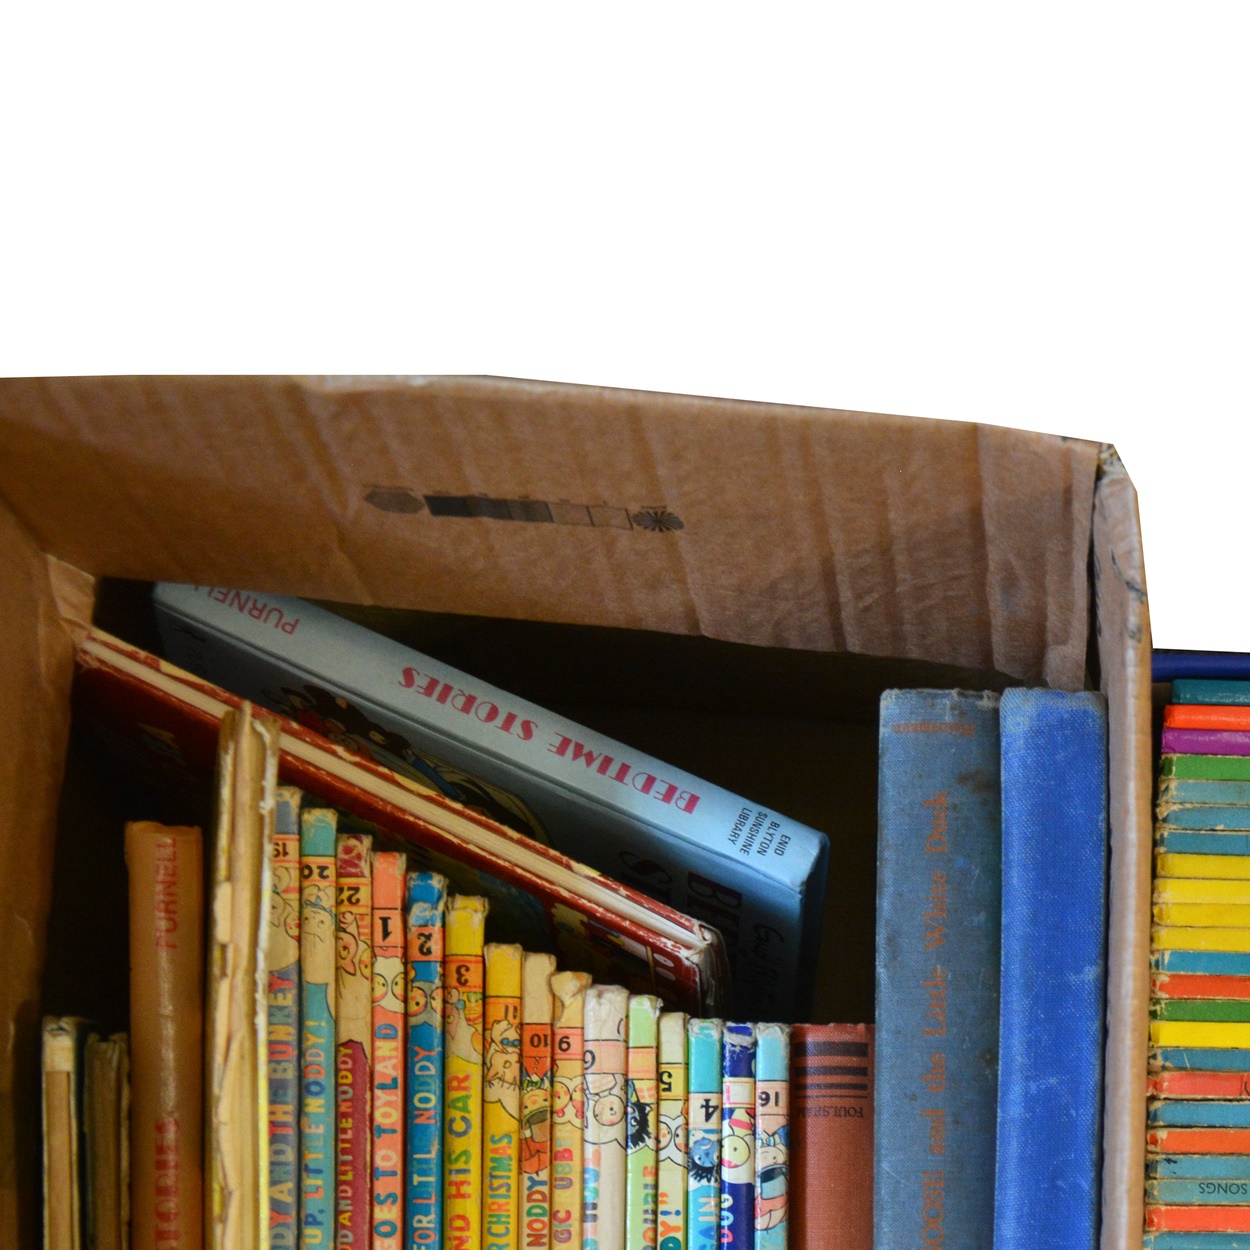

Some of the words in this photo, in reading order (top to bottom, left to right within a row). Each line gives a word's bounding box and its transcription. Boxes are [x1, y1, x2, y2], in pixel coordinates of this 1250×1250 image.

[397, 666, 539, 741] STORIES
[547, 732, 701, 815] BEDTIME
[728, 807, 752, 846] LIBRARY
[739, 811, 769, 857] SUNSHINE
[756, 821, 781, 857] BLYTON
[776, 833, 792, 857] ENID
[379, 916, 393, 941] 1
[455, 964, 470, 985] 3
[530, 1026, 548, 1047] 10
[375, 1023, 398, 1139] TOYLAND
[659, 1070, 672, 1093] 5
[447, 1073, 471, 1137] CAR
[375, 1149, 398, 1180] TO
[447, 1148, 471, 1199] HIS
[489, 1134, 513, 1238] CHRISTMAS
[526, 1174, 548, 1248] NODDY
